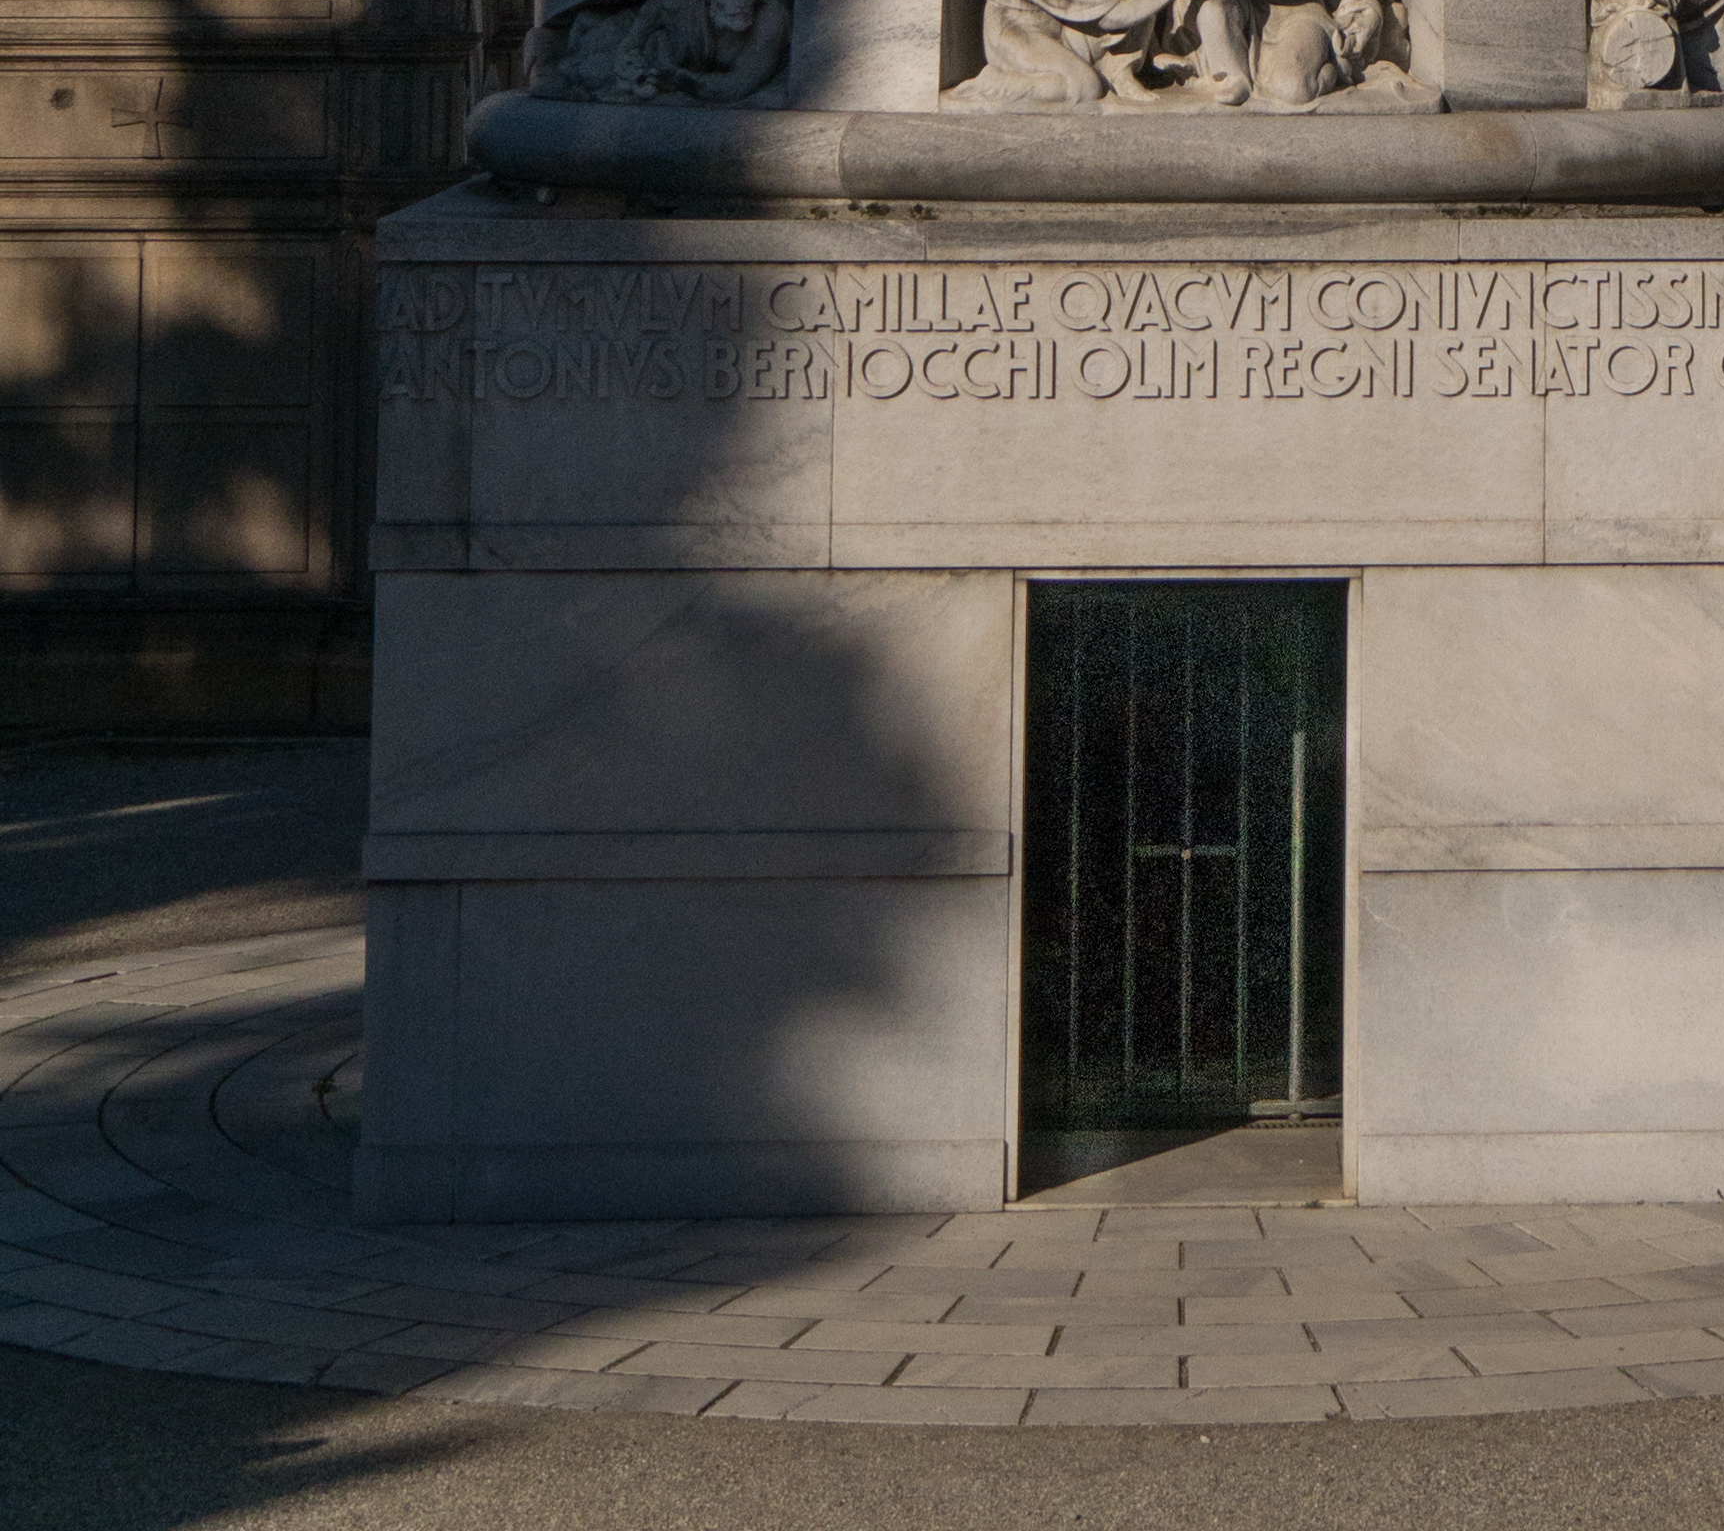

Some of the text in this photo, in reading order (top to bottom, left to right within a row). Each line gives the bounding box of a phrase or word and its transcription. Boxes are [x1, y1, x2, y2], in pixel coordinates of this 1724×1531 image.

[382, 272, 467, 333] AD
[766, 272, 1034, 333] CAMILLAE
[380, 339, 684, 401] ANTONIVS
[704, 339, 1056, 400] BERNOCCHI
[1076, 338, 1217, 399] OLIM
[1239, 337, 1414, 399] REGNI
[1432, 337, 1694, 398] SENATOR
